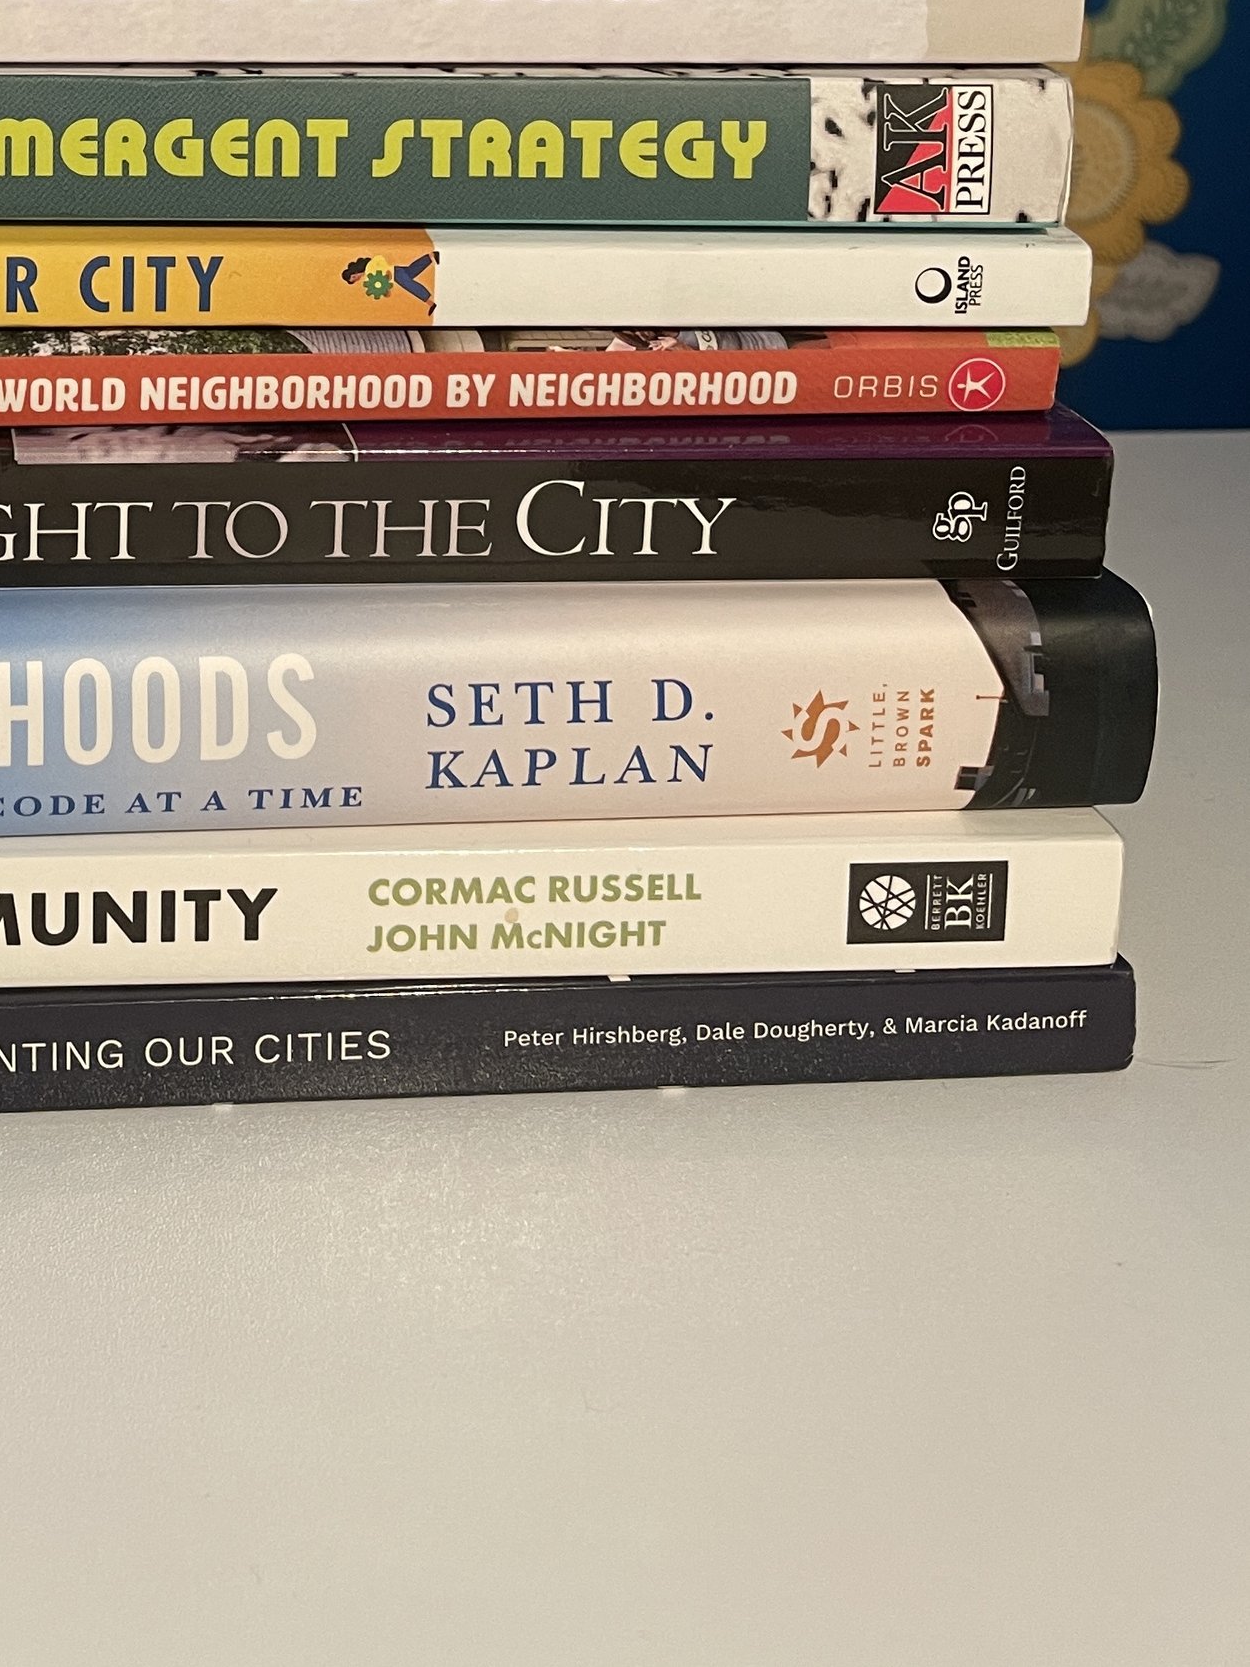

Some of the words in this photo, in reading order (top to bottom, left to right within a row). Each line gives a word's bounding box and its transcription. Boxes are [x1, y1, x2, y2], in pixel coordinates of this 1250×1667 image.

[371, 118, 767, 181] STRATEGY
[882, 87, 949, 211] AK
[955, 90, 988, 210] PRESS
[78, 254, 224, 315] CITY
[954, 255, 971, 315] ISLAND
[969, 264, 984, 307] PRESS
[140, 372, 430, 413] NEIGHBORHOOD
[446, 373, 496, 409] BY
[509, 370, 797, 409] NEIGHBORHOOD
[833, 375, 939, 399] ORBIS
[172, 500, 288, 560] TO
[310, 498, 493, 559] THE
[515, 479, 738, 557] CITY
[996, 465, 1027, 571] GUILFORD
[426, 679, 614, 729] SETH
[651, 677, 716, 722] D.
[869, 683, 888, 768] LITTLE,
[893, 691, 910, 767] BROWN
[916, 688, 935, 767] SPARK
[425, 743, 714, 792] KAPLAN
[126, 789, 185, 814] AT
[202, 789, 229, 812] A
[247, 785, 365, 810] TIME
[368, 876, 535, 907] CORMAC
[549, 872, 702, 903] RUSSELL
[931, 874, 942, 930] BERRETT
[944, 874, 974, 930] BK
[976, 873, 987, 929] KOEHLER
[366, 920, 477, 953] JOHN
[490, 918, 667, 951] McNIGHT
[145, 1034, 236, 1067] OUR
[254, 1029, 392, 1065] CITIES
[504, 1028, 564, 1048] Peter
[572, 1022, 688, 1050] Hirshberg,
[696, 1022, 746, 1041] Dale
[753, 1017, 876, 1045] Dougherty,
[882, 1017, 898, 1035] &
[905, 1015, 978, 1034] Marcia
[986, 1010, 1088, 1031] Kadanoff
